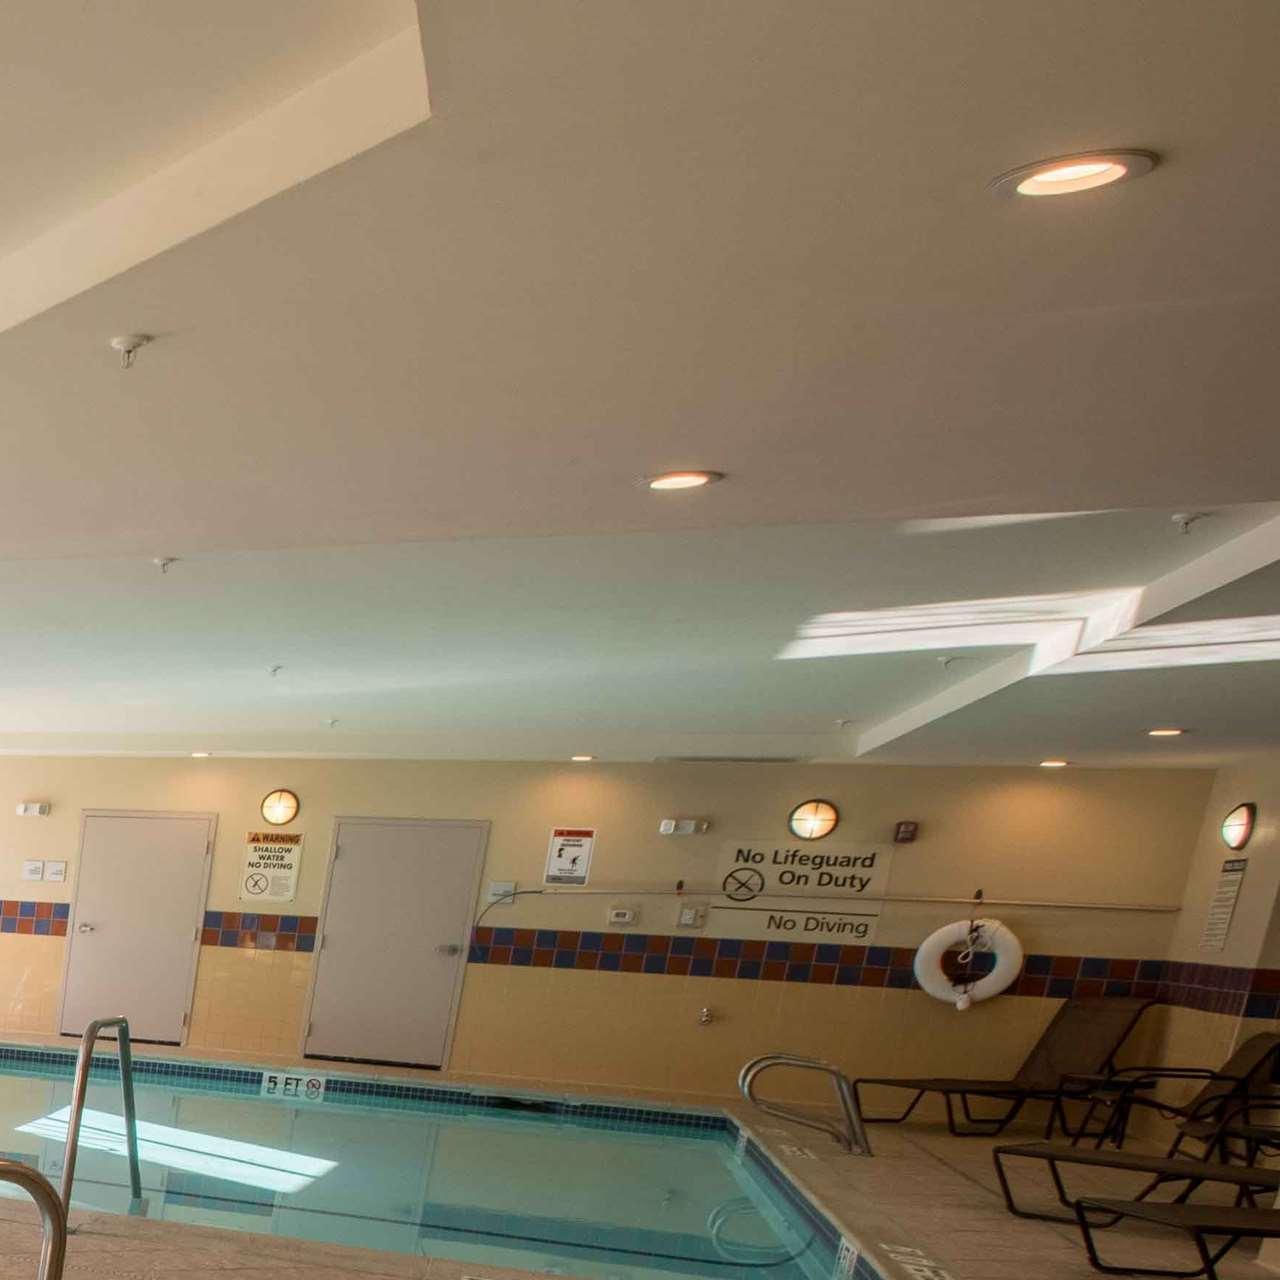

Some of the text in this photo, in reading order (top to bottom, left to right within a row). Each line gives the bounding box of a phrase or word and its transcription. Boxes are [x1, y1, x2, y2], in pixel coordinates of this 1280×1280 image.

[263, 833, 301, 844] WARNING
[253, 846, 293, 854] SHALLOW
[248, 861, 293, 870] NO DIVING
[735, 849, 876, 870] No Lifeguard
[778, 870, 871, 893] On Duty
[767, 915, 869, 938] No Diving
